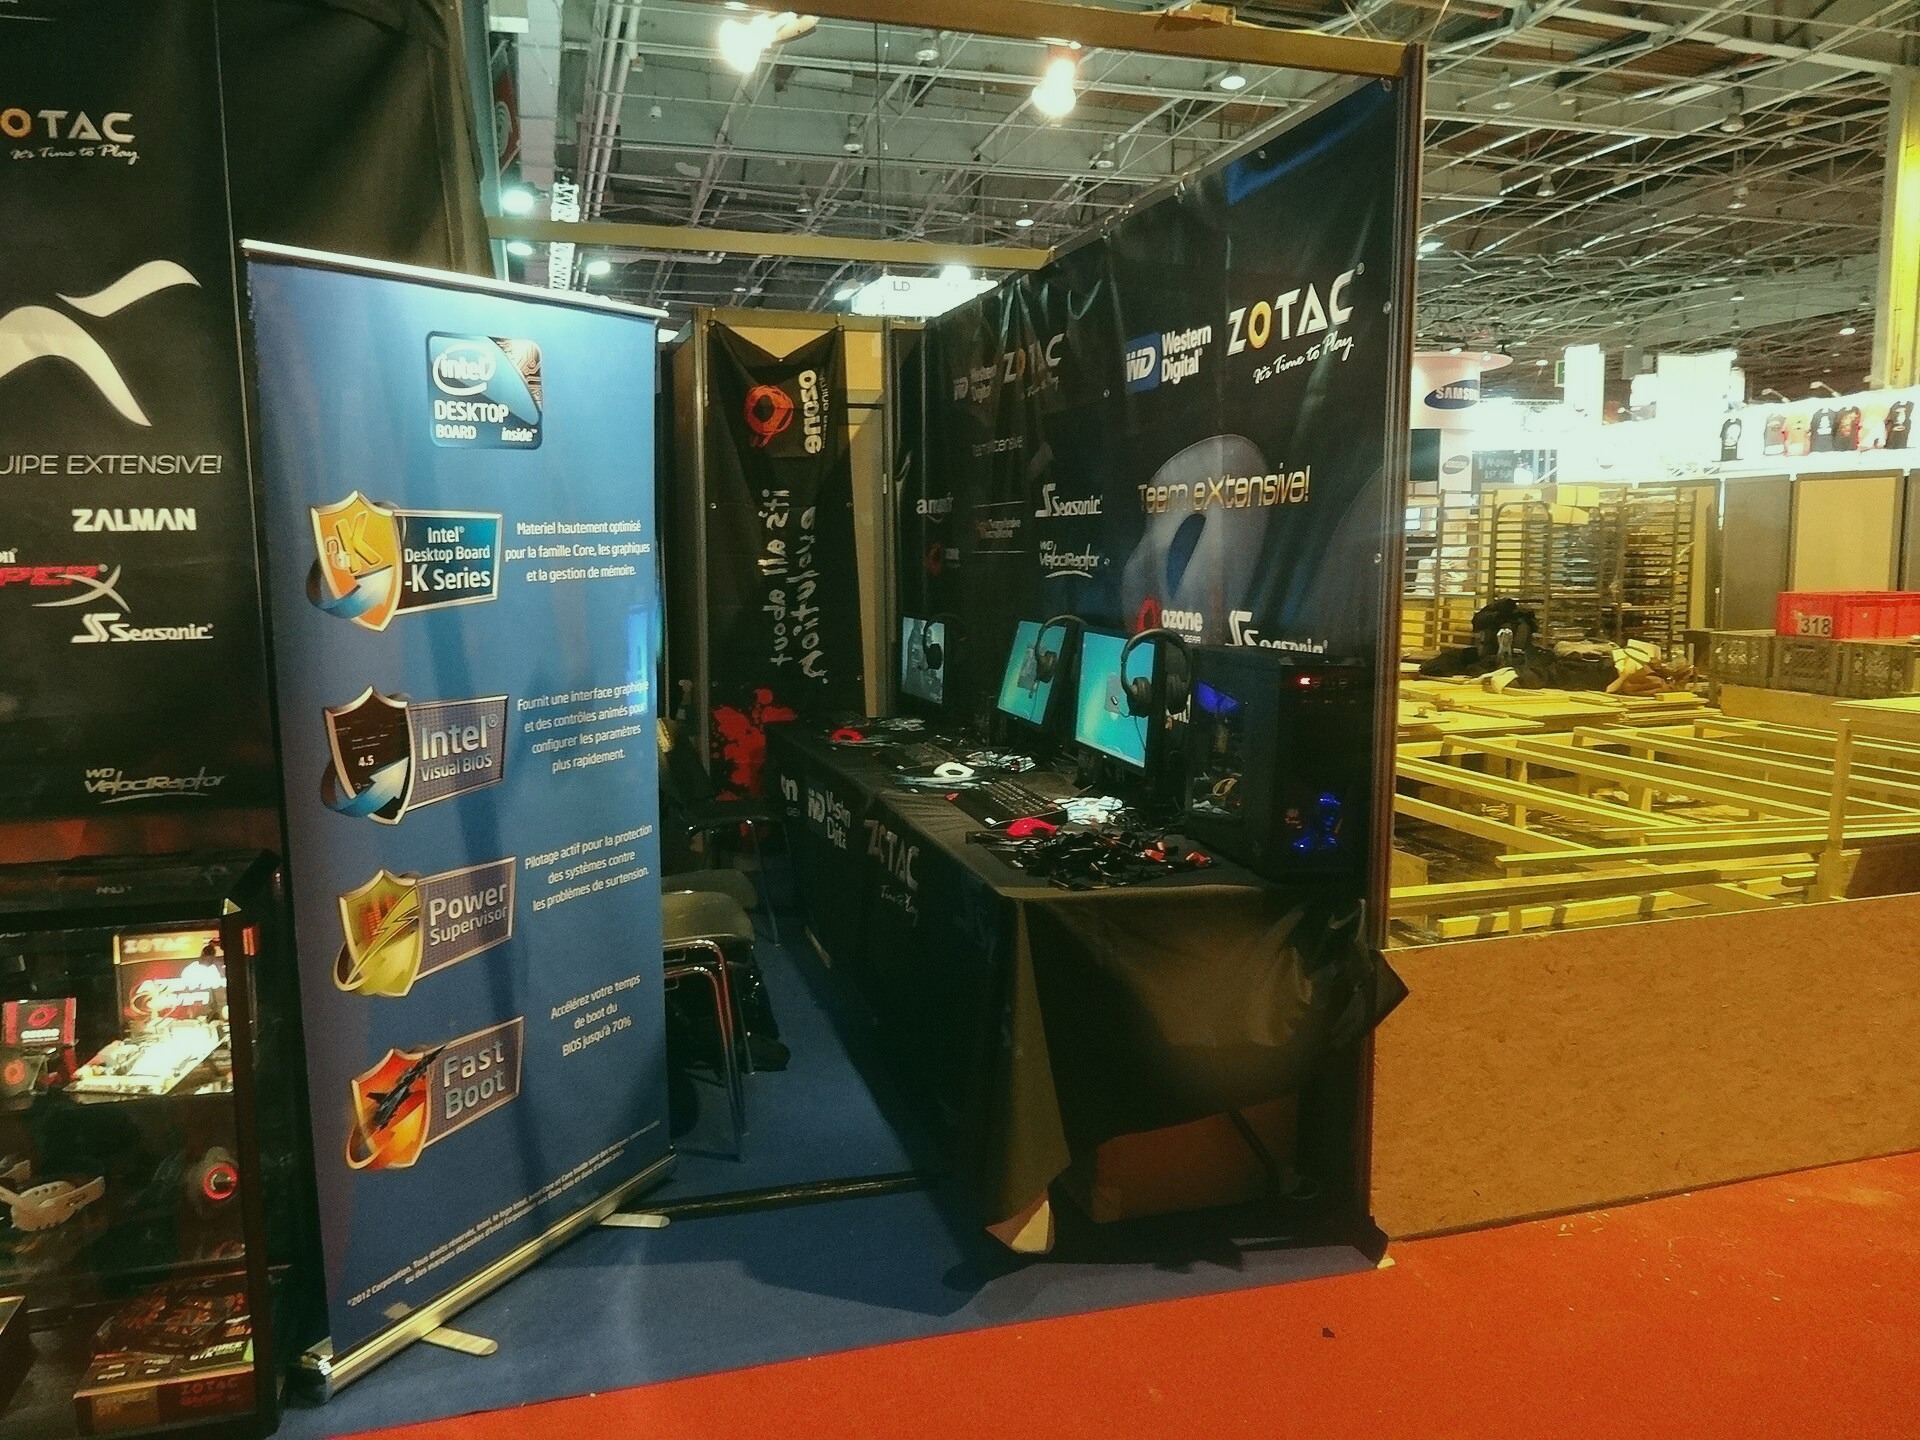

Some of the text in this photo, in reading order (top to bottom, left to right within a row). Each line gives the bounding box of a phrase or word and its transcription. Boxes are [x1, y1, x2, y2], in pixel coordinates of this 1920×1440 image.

[79, 147, 95, 157] to
[1226, 269, 1356, 357] ZOTAC
[1161, 325, 1212, 357] Western
[1161, 349, 1201, 385] Digital
[1253, 330, 1355, 384] It's Time to Play
[434, 400, 509, 423] DESKTOP
[435, 424, 476, 439] BOARD
[66, 454, 223, 475] EXTENSIVE!
[1138, 483, 1188, 513] Team
[71, 507, 197, 532] ZALMAN
[558, 522, 608, 535] hautement
[609, 520, 641, 535] optimisé
[404, 545, 490, 563] Desktop Board
[505, 549, 526, 562] pour
[528, 546, 536, 558] la
[538, 544, 571, 558] famille
[598, 544, 611, 556] les
[612, 542, 650, 557] graphiques
[433, 567, 491, 591] Series
[526, 570, 537, 582] et
[539, 569, 547, 581] la
[550, 567, 585, 583] gestion
[587, 566, 599, 578] de
[1161, 609, 1203, 632] ozone
[1801, 617, 1831, 635] 318
[517, 695, 550, 711] Fournit
[551, 694, 569, 706] une
[571, 687, 613, 702] interface
[524, 722, 534, 733] et
[535, 719, 552, 731] des
[554, 711, 596, 727] contrôles
[598, 704, 628, 720] animés
[532, 724, 641, 754] configurer les paramètres
[420, 761, 460, 782] Visual
[552, 759, 572, 774] plus
[525, 825, 653, 870] Pilotage actif pour la protection
[548, 851, 636, 885] des systèmes contre
[429, 883, 507, 926] Power
[533, 900, 546, 912] les
[547, 884, 591, 909] problèmes
[592, 880, 604, 892] de
[429, 906, 507, 946] Supervisor
[551, 974, 641, 1020] Accélérez votre temps
[574, 1002, 618, 1030] de boot du
[562, 1037, 582, 1057] BIOS
[612, 1015, 632, 1033] 70%
[443, 1040, 505, 1088] Fast
[445, 1069, 506, 1120] Boot
